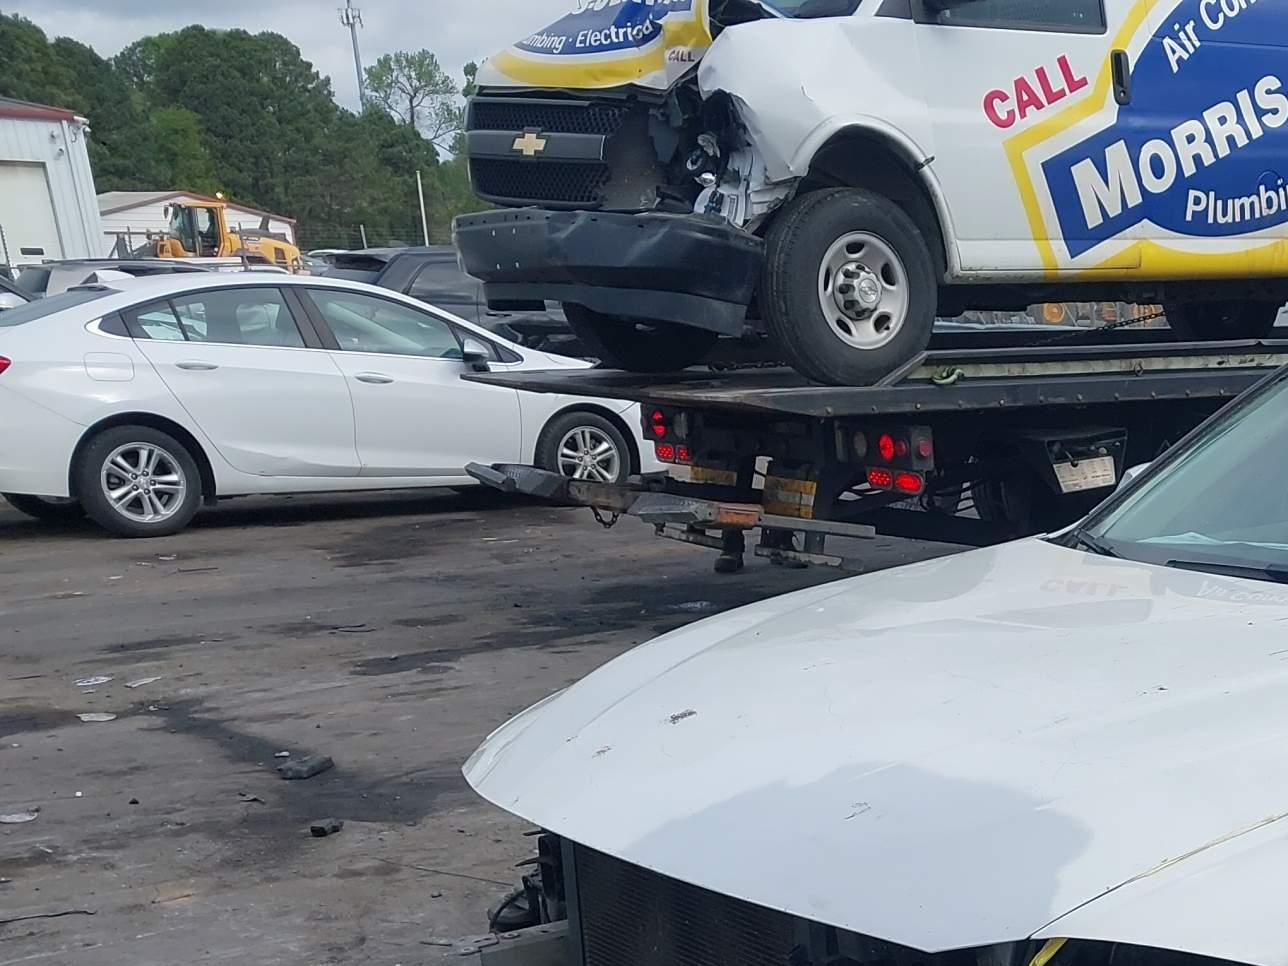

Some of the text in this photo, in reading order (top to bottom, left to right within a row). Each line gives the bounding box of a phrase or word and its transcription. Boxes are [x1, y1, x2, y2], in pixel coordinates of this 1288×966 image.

[524, 32, 567, 53] mbing
[668, 50, 695, 62] CALL
[1161, 20, 1201, 74] Air
[983, 54, 1088, 128] CALL
